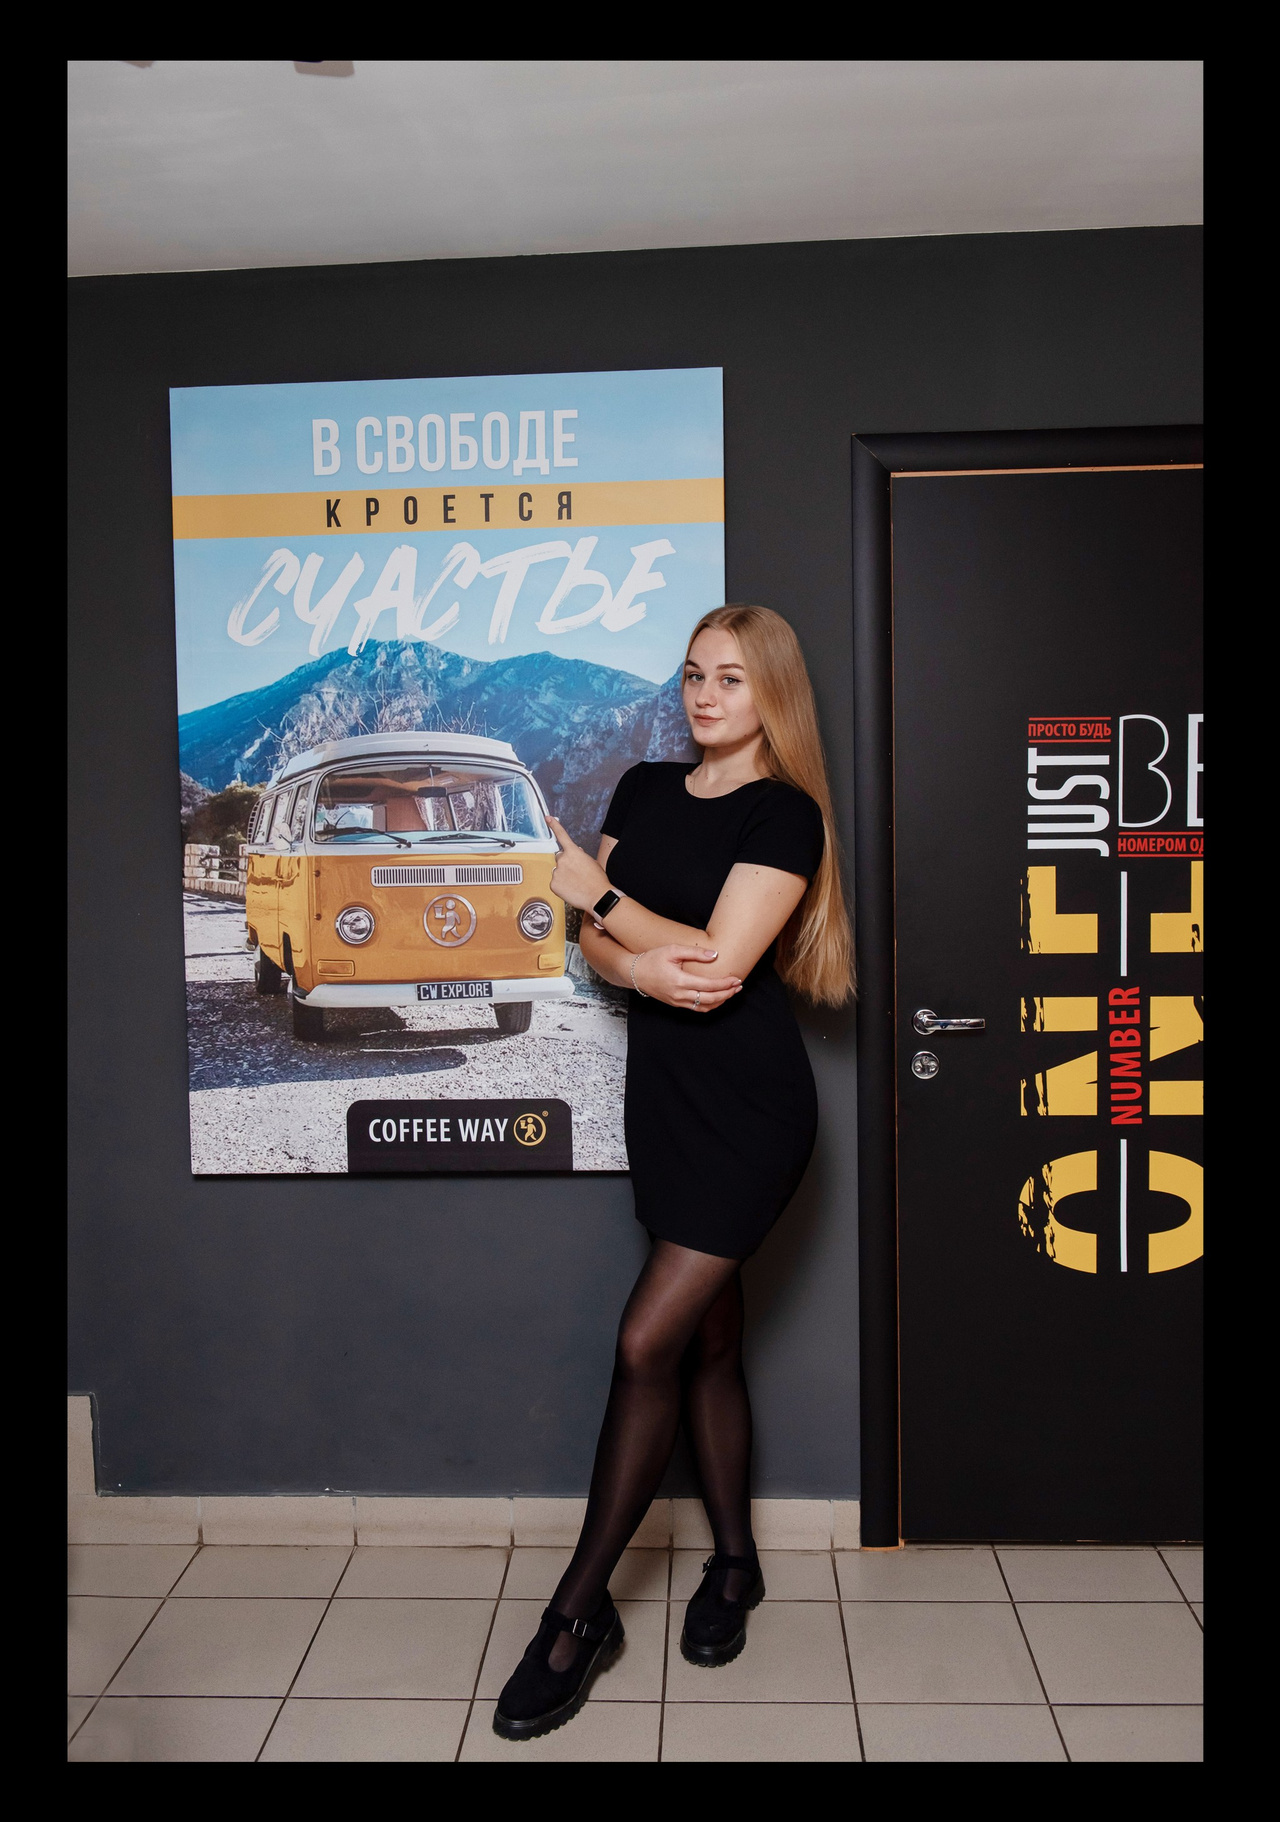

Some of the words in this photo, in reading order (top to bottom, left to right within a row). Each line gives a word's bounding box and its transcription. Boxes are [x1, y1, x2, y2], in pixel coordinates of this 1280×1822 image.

[312, 418, 341, 476] В
[355, 409, 579, 477] СВОБОДЕ
[326, 490, 573, 528] КРОЕТСЯ
[227, 535, 677, 657] СЧАСТЬЕ
[1028, 723, 1076, 737] ПРОСТО
[1079, 722, 1112, 739] БУДЬ
[1027, 747, 1110, 857] JUST
[1117, 837, 1187, 852] НОМЕРОМ
[420, 985, 438, 1000] CW
[441, 982, 490, 998] EXPLORE
[1108, 986, 1143, 1125] NUMBER
[368, 1118, 451, 1143] COFFEE
[457, 1118, 509, 1142] WAY
